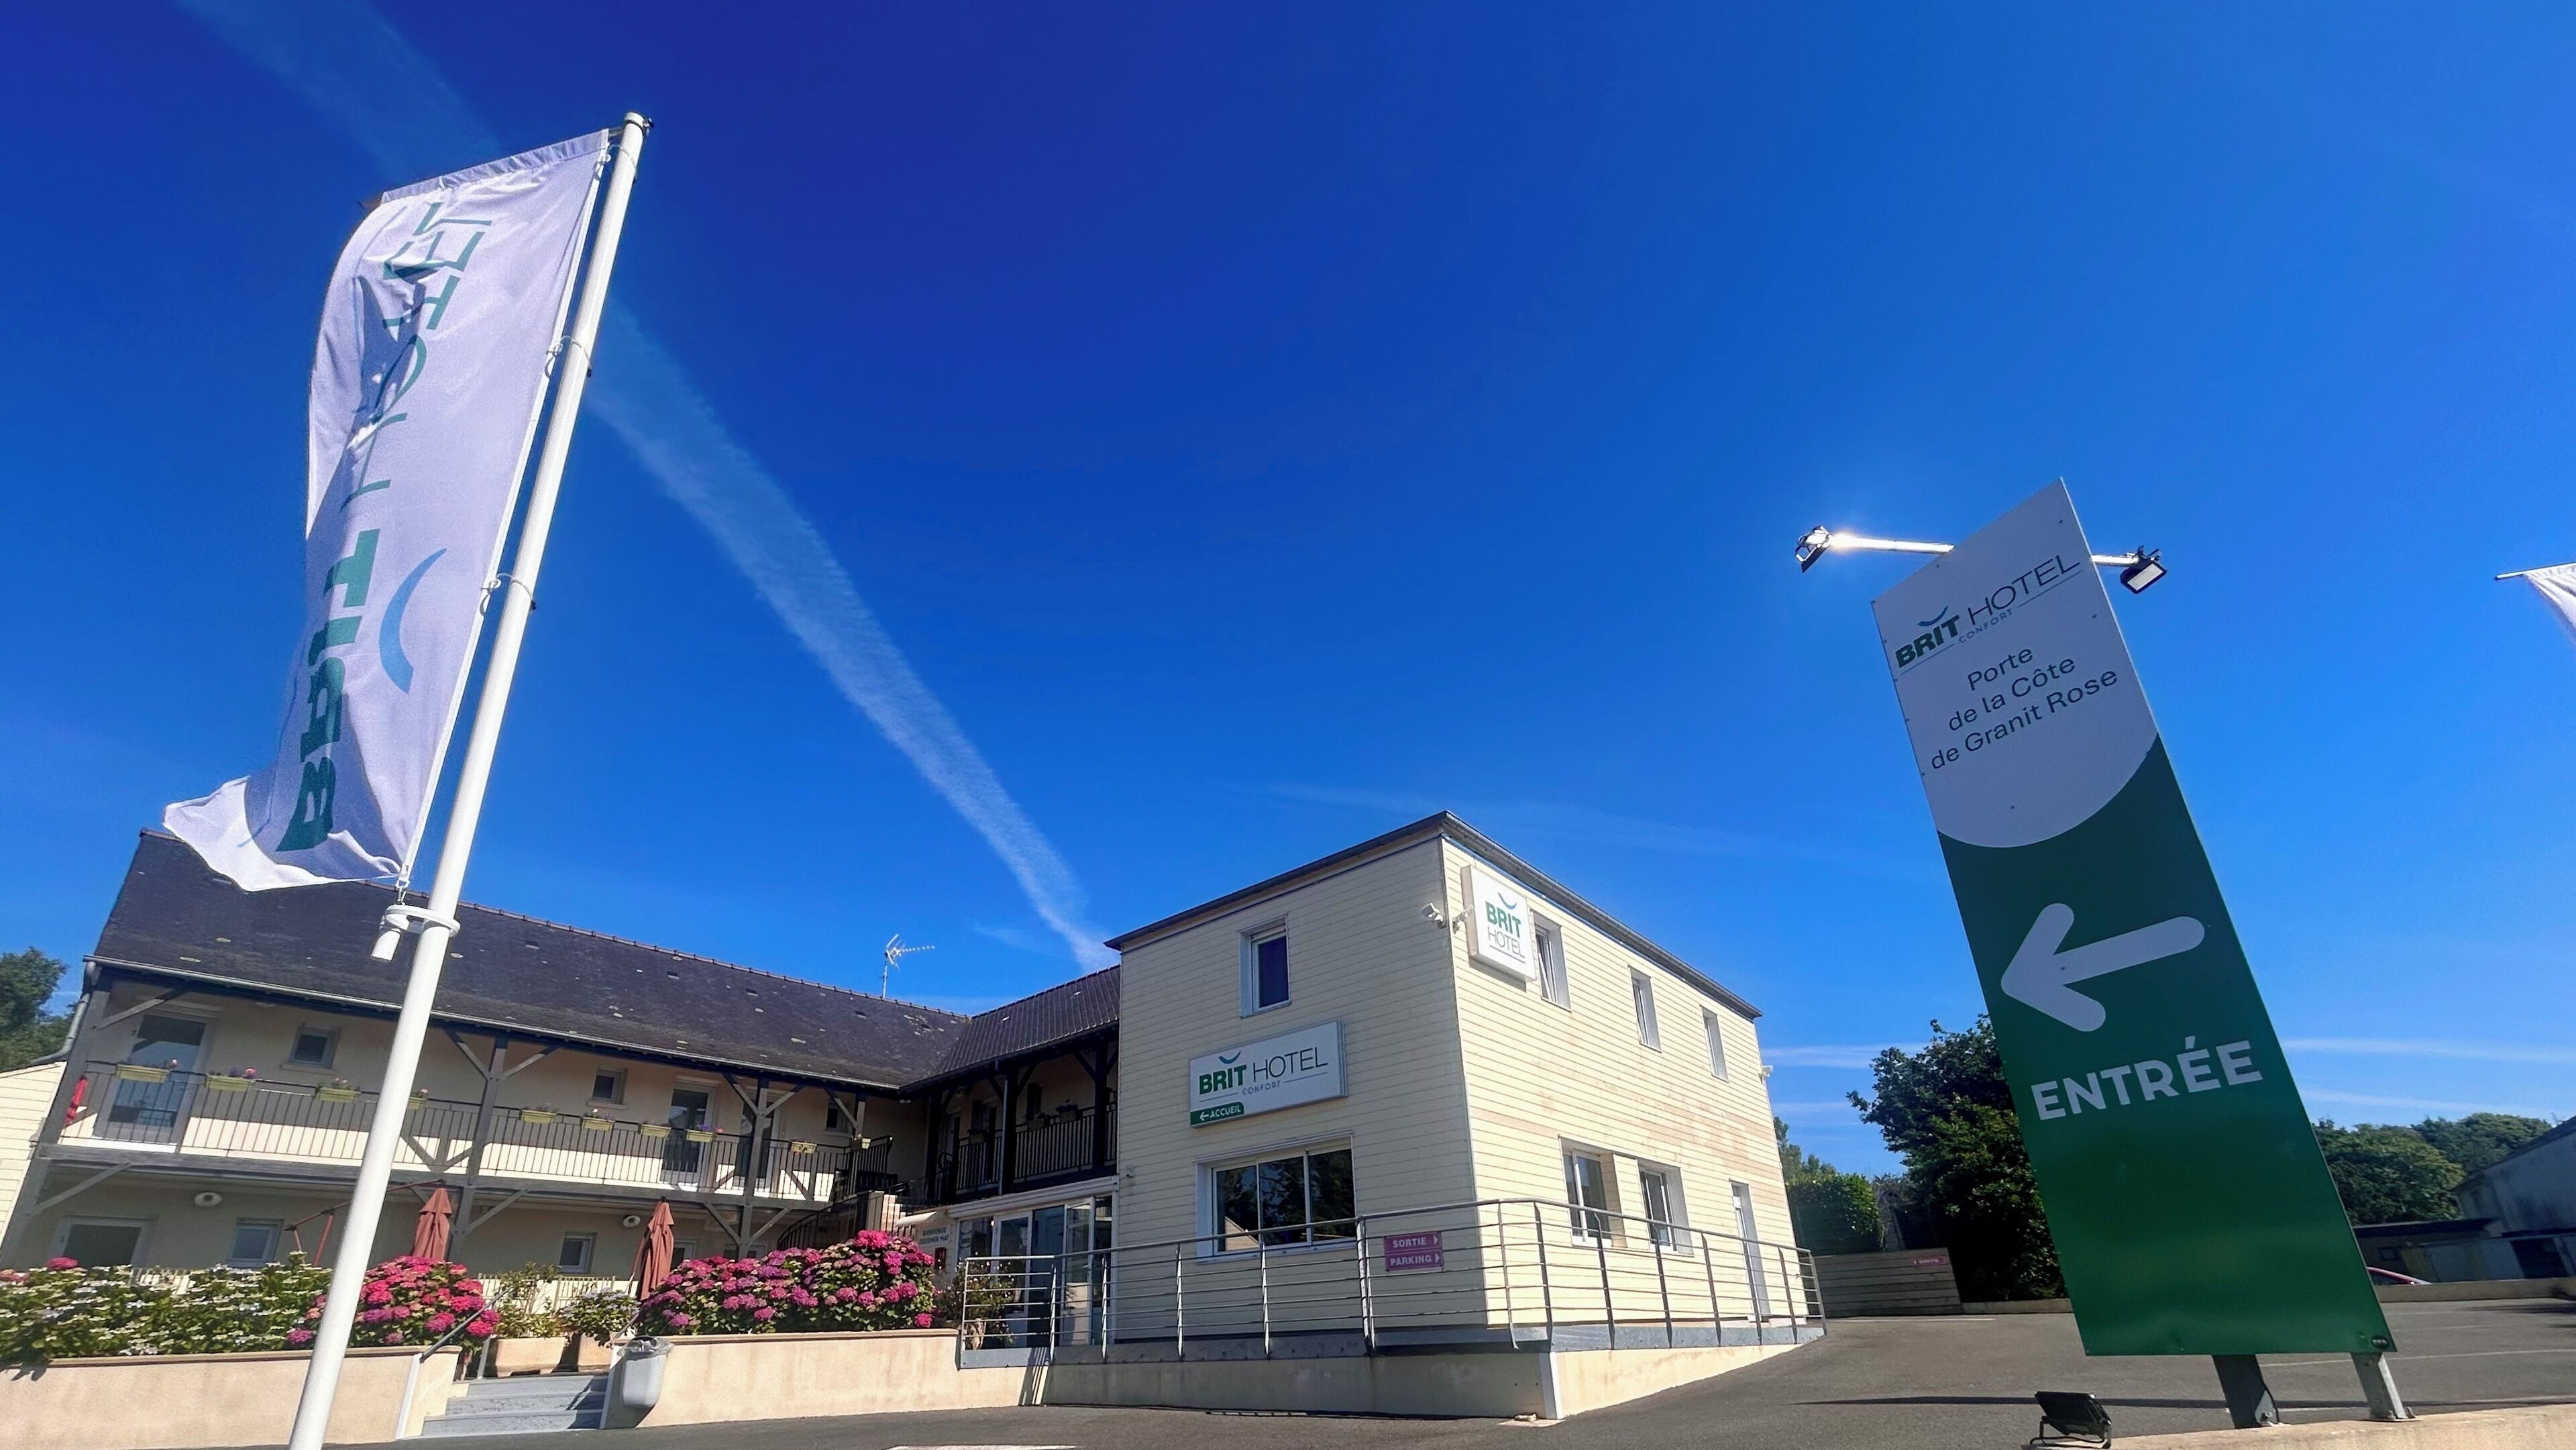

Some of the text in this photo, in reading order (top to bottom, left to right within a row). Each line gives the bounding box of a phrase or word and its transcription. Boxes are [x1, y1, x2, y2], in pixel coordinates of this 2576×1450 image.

[1895, 555, 2080, 668] BRIT HOTEL
[1958, 609, 2013, 643] CONFORT
[1968, 648, 2033, 691] Porte
[1949, 658, 2075, 731] de la Côte
[1931, 671, 2117, 769] de Granit Rose
[1485, 900, 1521, 939] BRIT
[1487, 925, 1525, 959] HOTEL
[1199, 1046, 1328, 1095] BRIT HOTEL
[1242, 1081, 1281, 1096] CONFORT
[2031, 1035, 2263, 1121] ENTRÉE
[1210, 1104, 1242, 1119] ACCUEIL
[1390, 1254, 1432, 1266] PARKING
[1393, 1237, 1426, 1248] SORTIE
